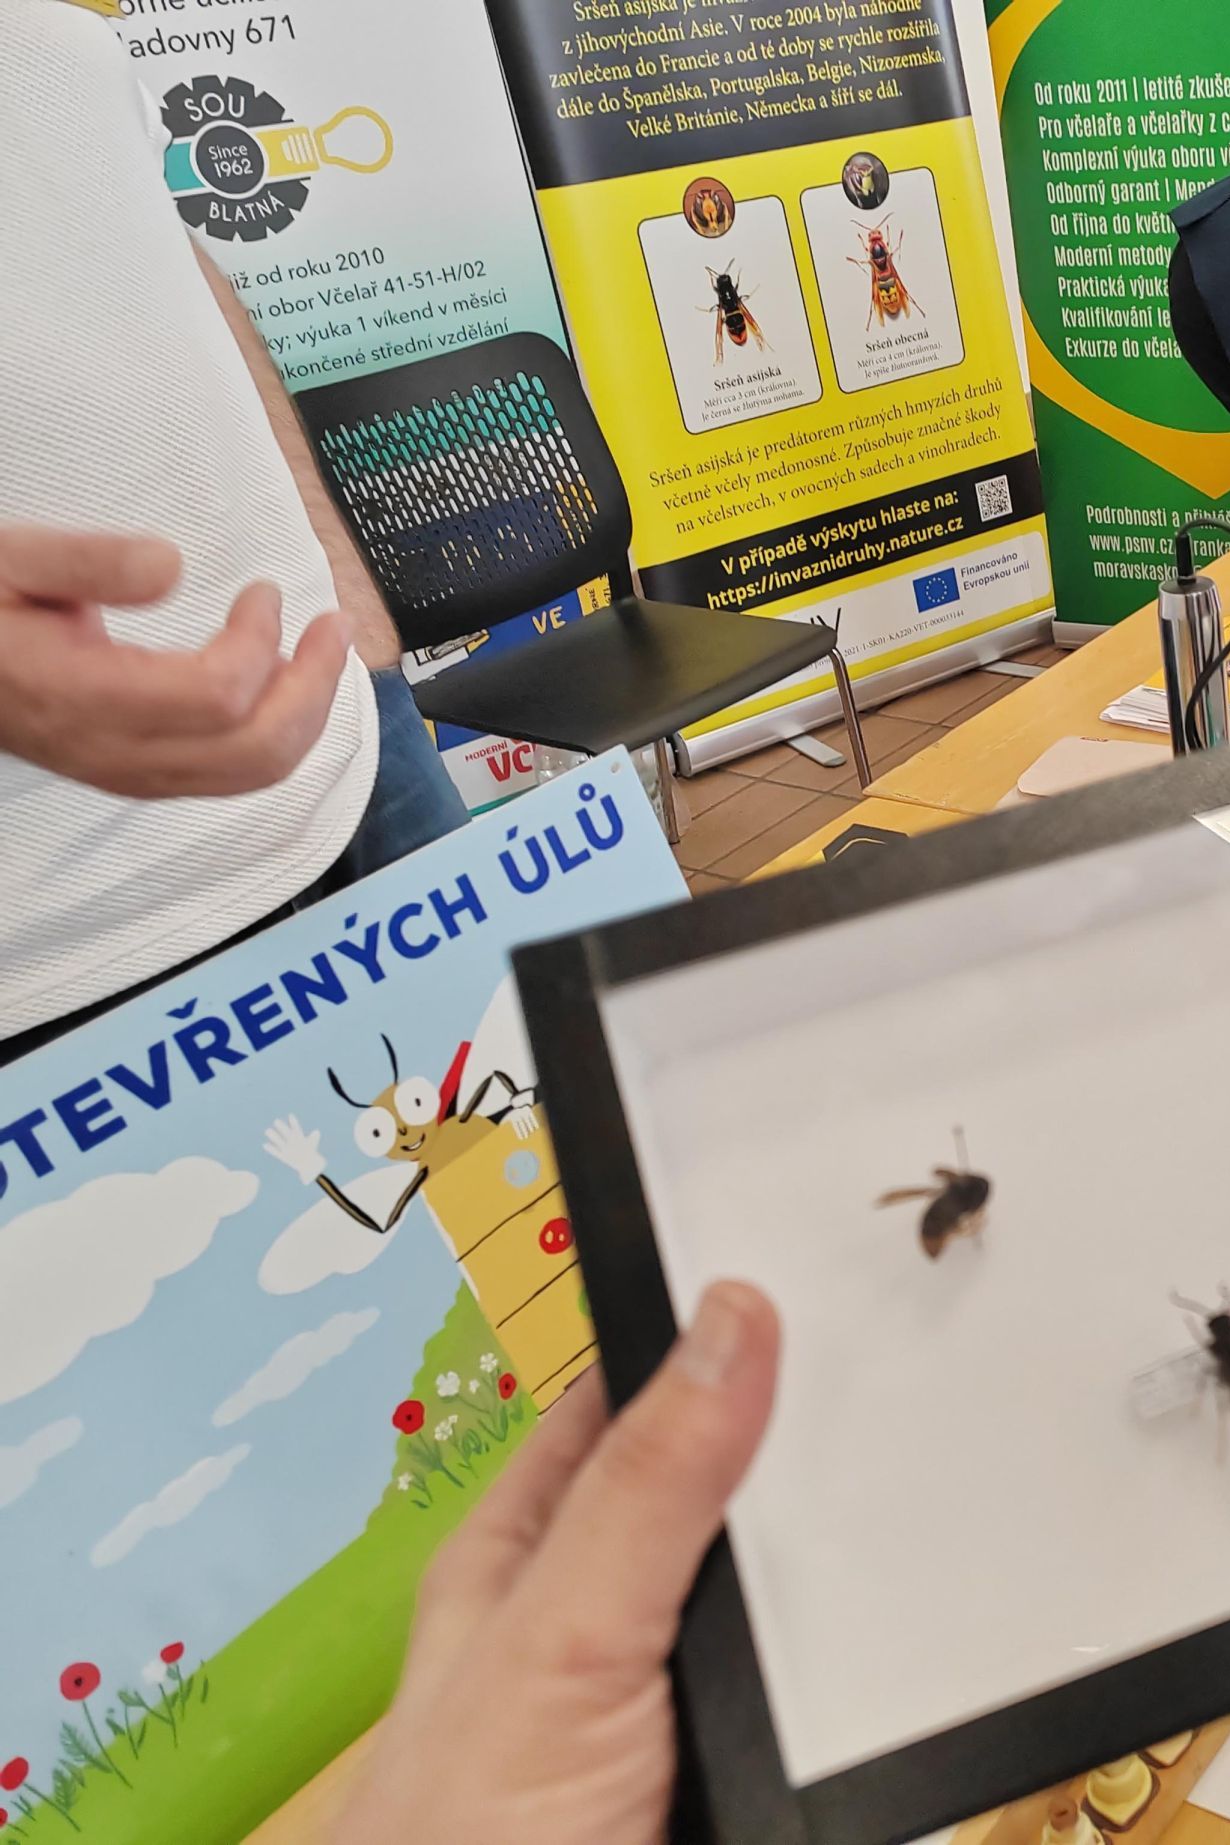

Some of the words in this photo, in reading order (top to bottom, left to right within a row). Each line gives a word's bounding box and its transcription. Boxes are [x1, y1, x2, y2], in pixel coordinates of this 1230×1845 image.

[245, 14, 296, 44] 671
[562, 41, 573, 55] z
[575, 21, 686, 59] jihovýchodní
[690, 18, 729, 39] Asie.
[730, 14, 745, 33] V
[750, 14, 783, 32] roce
[785, 7, 822, 27] 2004
[824, 2, 858, 27] byla
[549, 63, 632, 89] zavlečena
[635, 56, 657, 77] do
[659, 49, 721, 73] Francie
[723, 52, 733, 65] a
[736, 42, 758, 62] od
[760, 40, 775, 59] té
[778, 37, 815, 59] doby
[819, 37, 834, 52] se
[838, 25, 884, 53] rychle
[886, 18, 941, 42] rozšířila
[556, 96, 595, 119] dále
[597, 92, 621, 113] do
[622, 81, 707, 114] Španělska,
[709, 67, 805, 96] Portugalska,
[806, 60, 857, 83] Belgie,
[859, 45, 946, 74] Nizozemska,
[1034, 82, 1053, 105] Od
[1057, 80, 1091, 104] roku
[1096, 78, 1128, 103] 2011
[1143, 74, 1184, 101] letité
[184, 92, 245, 121] SOU
[626, 113, 673, 139] Velké
[674, 105, 744, 132] Británie,
[745, 93, 817, 121] Německa
[819, 96, 828, 109] a
[831, 86, 855, 107] šíří
[858, 88, 874, 103] se
[876, 79, 903, 100] dál.
[1038, 115, 1062, 139] Pro
[1066, 112, 1122, 138] včelaře
[1127, 115, 1136, 136] a
[1140, 109, 1204, 136] včelařky
[1209, 112, 1217, 133] z
[208, 144, 248, 160] Since
[1042, 146, 1119, 173] Komplexní
[1123, 144, 1166, 171] výuka
[1171, 145, 1216, 168] oboru
[214, 158, 253, 178] 1962
[1046, 179, 1106, 205] Odborný
[1111, 179, 1161, 205] garant
[1050, 213, 1068, 236] Od
[1072, 212, 1108, 237] října
[1112, 213, 1131, 235] do
[256, 265, 283, 286] od
[288, 259, 332, 280] roku
[335, 247, 385, 271] 2010
[1054, 244, 1113, 267] Moderní
[1118, 244, 1172, 268] metody
[268, 298, 315, 317] obor
[317, 281, 378, 306] Včelař
[384, 260, 487, 295] 41-51-H/02
[1057, 274, 1125, 298] Praktická
[1130, 275, 1170, 300] výuka
[296, 321, 353, 347] výuka
[357, 316, 367, 332] 1
[373, 301, 434, 329] víkend
[438, 304, 447, 315] v
[453, 287, 508, 312] měsíci
[1061, 306, 1153, 328] Kvalifikování
[371, 333, 433, 361] střední
[436, 317, 510, 347] vzdělání
[865, 337, 893, 353] Sršeň
[895, 328, 930, 346] obecná
[1065, 337, 1117, 358] Exkurze
[1122, 337, 1139, 358] do
[713, 374, 744, 391] Sršeň
[747, 366, 782, 384] asijská
[649, 464, 692, 488] Sršeň
[696, 447, 744, 475] asijská
[746, 445, 760, 466] je
[763, 423, 846, 460] predátorem
[849, 405, 902, 431] různých
[905, 389, 961, 416] hmyzích
[964, 376, 1003, 400] druhů
[662, 484, 712, 511] včetně
[714, 475, 751, 495] včely
[755, 448, 841, 484] medonosné.
[844, 428, 914, 460] Způsobuje
[917, 415, 962, 438] značné
[965, 403, 1001, 424] škody
[676, 519, 695, 534] na
[698, 493, 776, 527] včelstvech,
[778, 490, 787, 502] v
[790, 467, 856, 499] ovocných
[860, 453, 905, 479] sadech
[908, 454, 915, 465] a
[918, 426, 1001, 462] vinohradech.
[1086, 504, 1167, 527] Podrobnosti
[1172, 510, 1180, 528] a
[720, 556, 734, 575] V
[738, 532, 808, 574] případě
[810, 517, 877, 549] výskytu
[880, 498, 931, 527] hlaste
[934, 490, 960, 511] na:
[706, 516, 965, 611] https://invaznidruhy.nature.cz
[963, 567, 1012, 591] Evropskou
[465, 740, 508, 762] MODERNÍ
[0, 873, 488, 1200] TEVŘENÝCH
[497, 782, 624, 894] ÚLŮ
